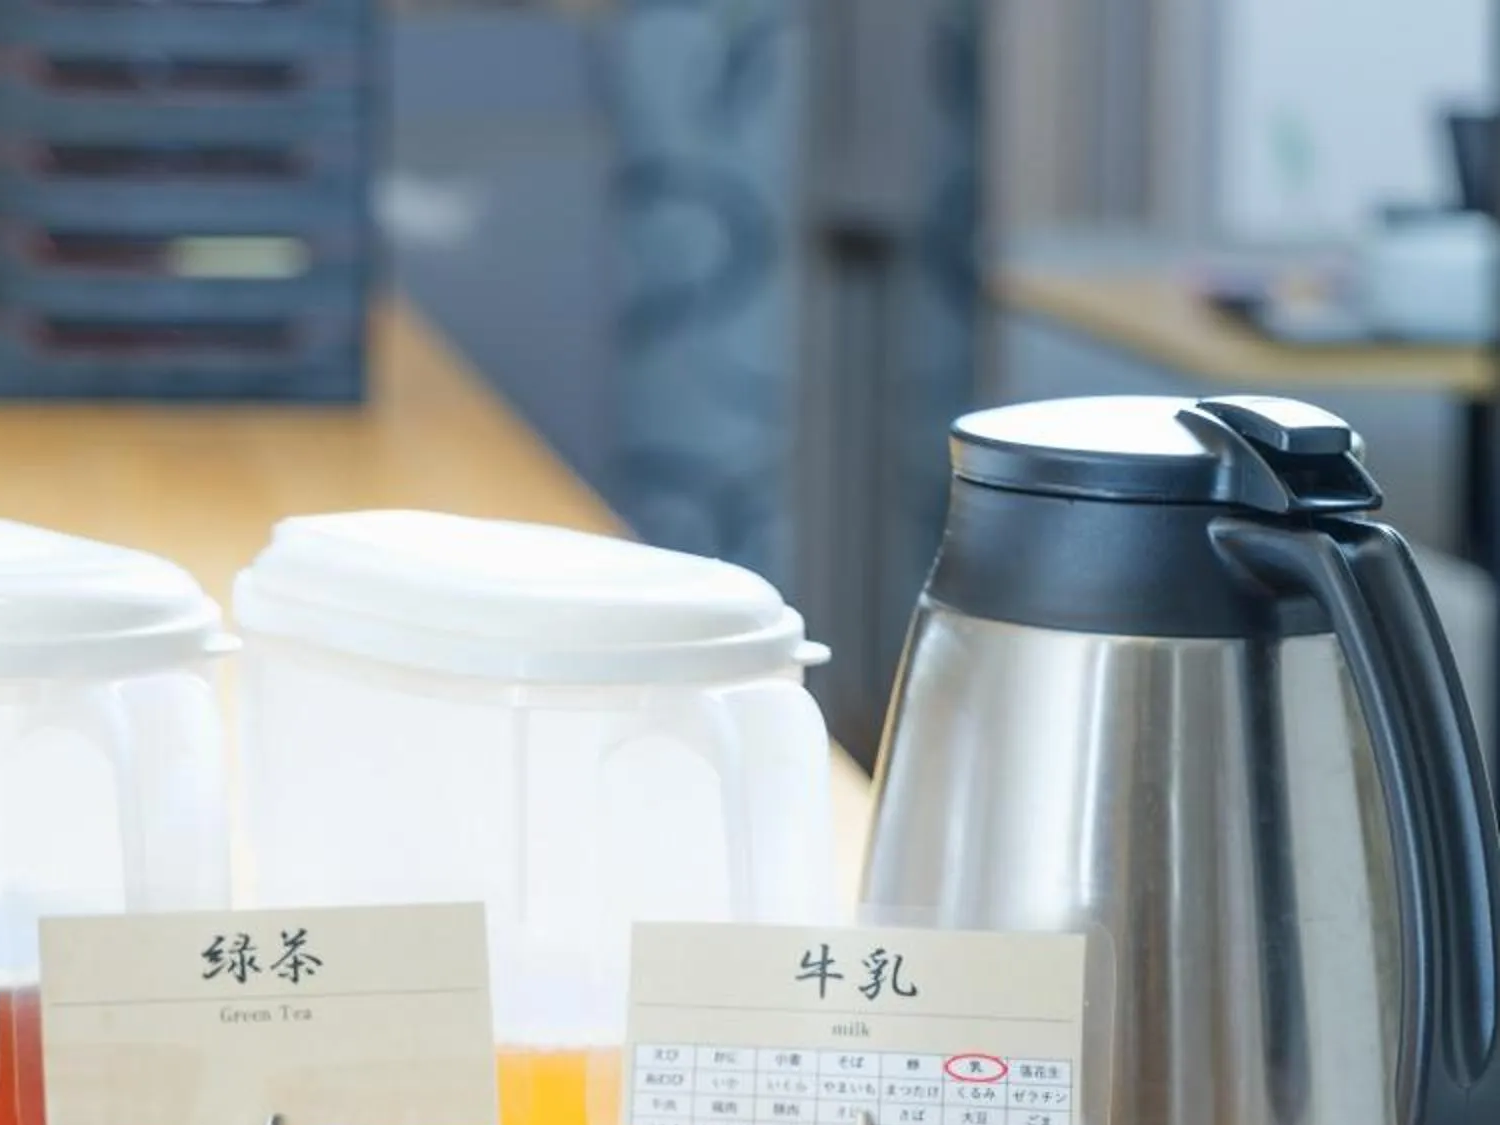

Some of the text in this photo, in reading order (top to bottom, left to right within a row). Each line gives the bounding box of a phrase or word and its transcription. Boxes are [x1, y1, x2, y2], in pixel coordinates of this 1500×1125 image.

[201, 928, 323, 984] 緑茶
[795, 944, 919, 1000] 牛乳
[219, 1004, 312, 1024] Green Tea
[831, 1019, 871, 1037] milk
[839, 1055, 865, 1069] そば
[956, 1087, 995, 1099] くるみ
[1012, 1091, 1068, 1104] ゼラチン
[961, 1111, 988, 1125] 大豆
